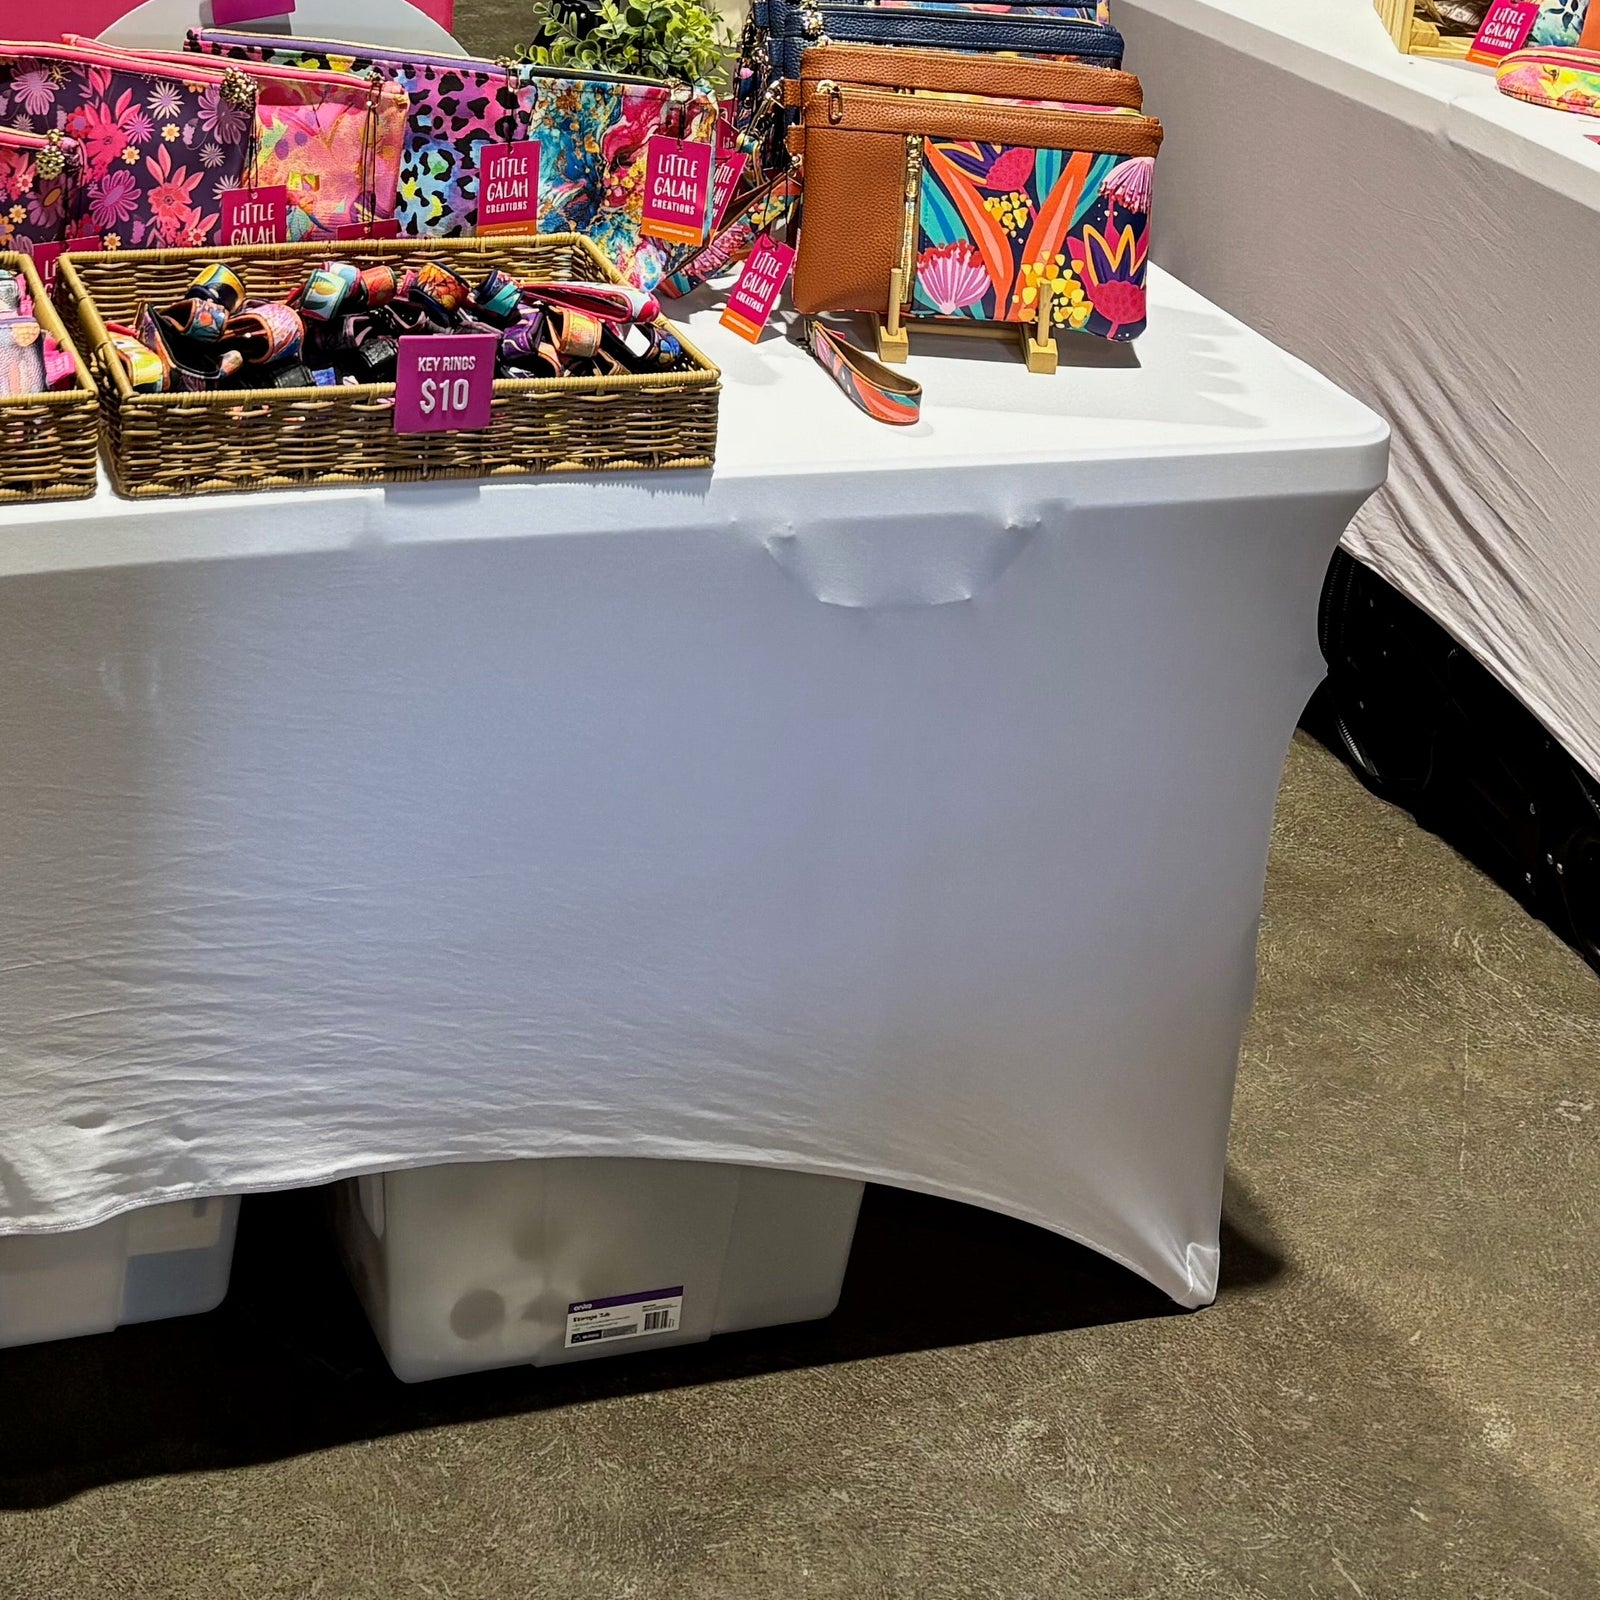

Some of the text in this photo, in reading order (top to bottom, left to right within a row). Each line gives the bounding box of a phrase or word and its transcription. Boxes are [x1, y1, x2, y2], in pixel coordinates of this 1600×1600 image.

[487, 178, 528, 201] GALAH
[653, 177, 697, 203] GALAH
[485, 201, 528, 214] CREATIONS
[652, 198, 695, 215] CREATIONS
[231, 225, 276, 245] GALAH
[742, 272, 775, 302] GALAH
[418, 355, 476, 372] KEY RINGS
[420, 378, 469, 413] $10
